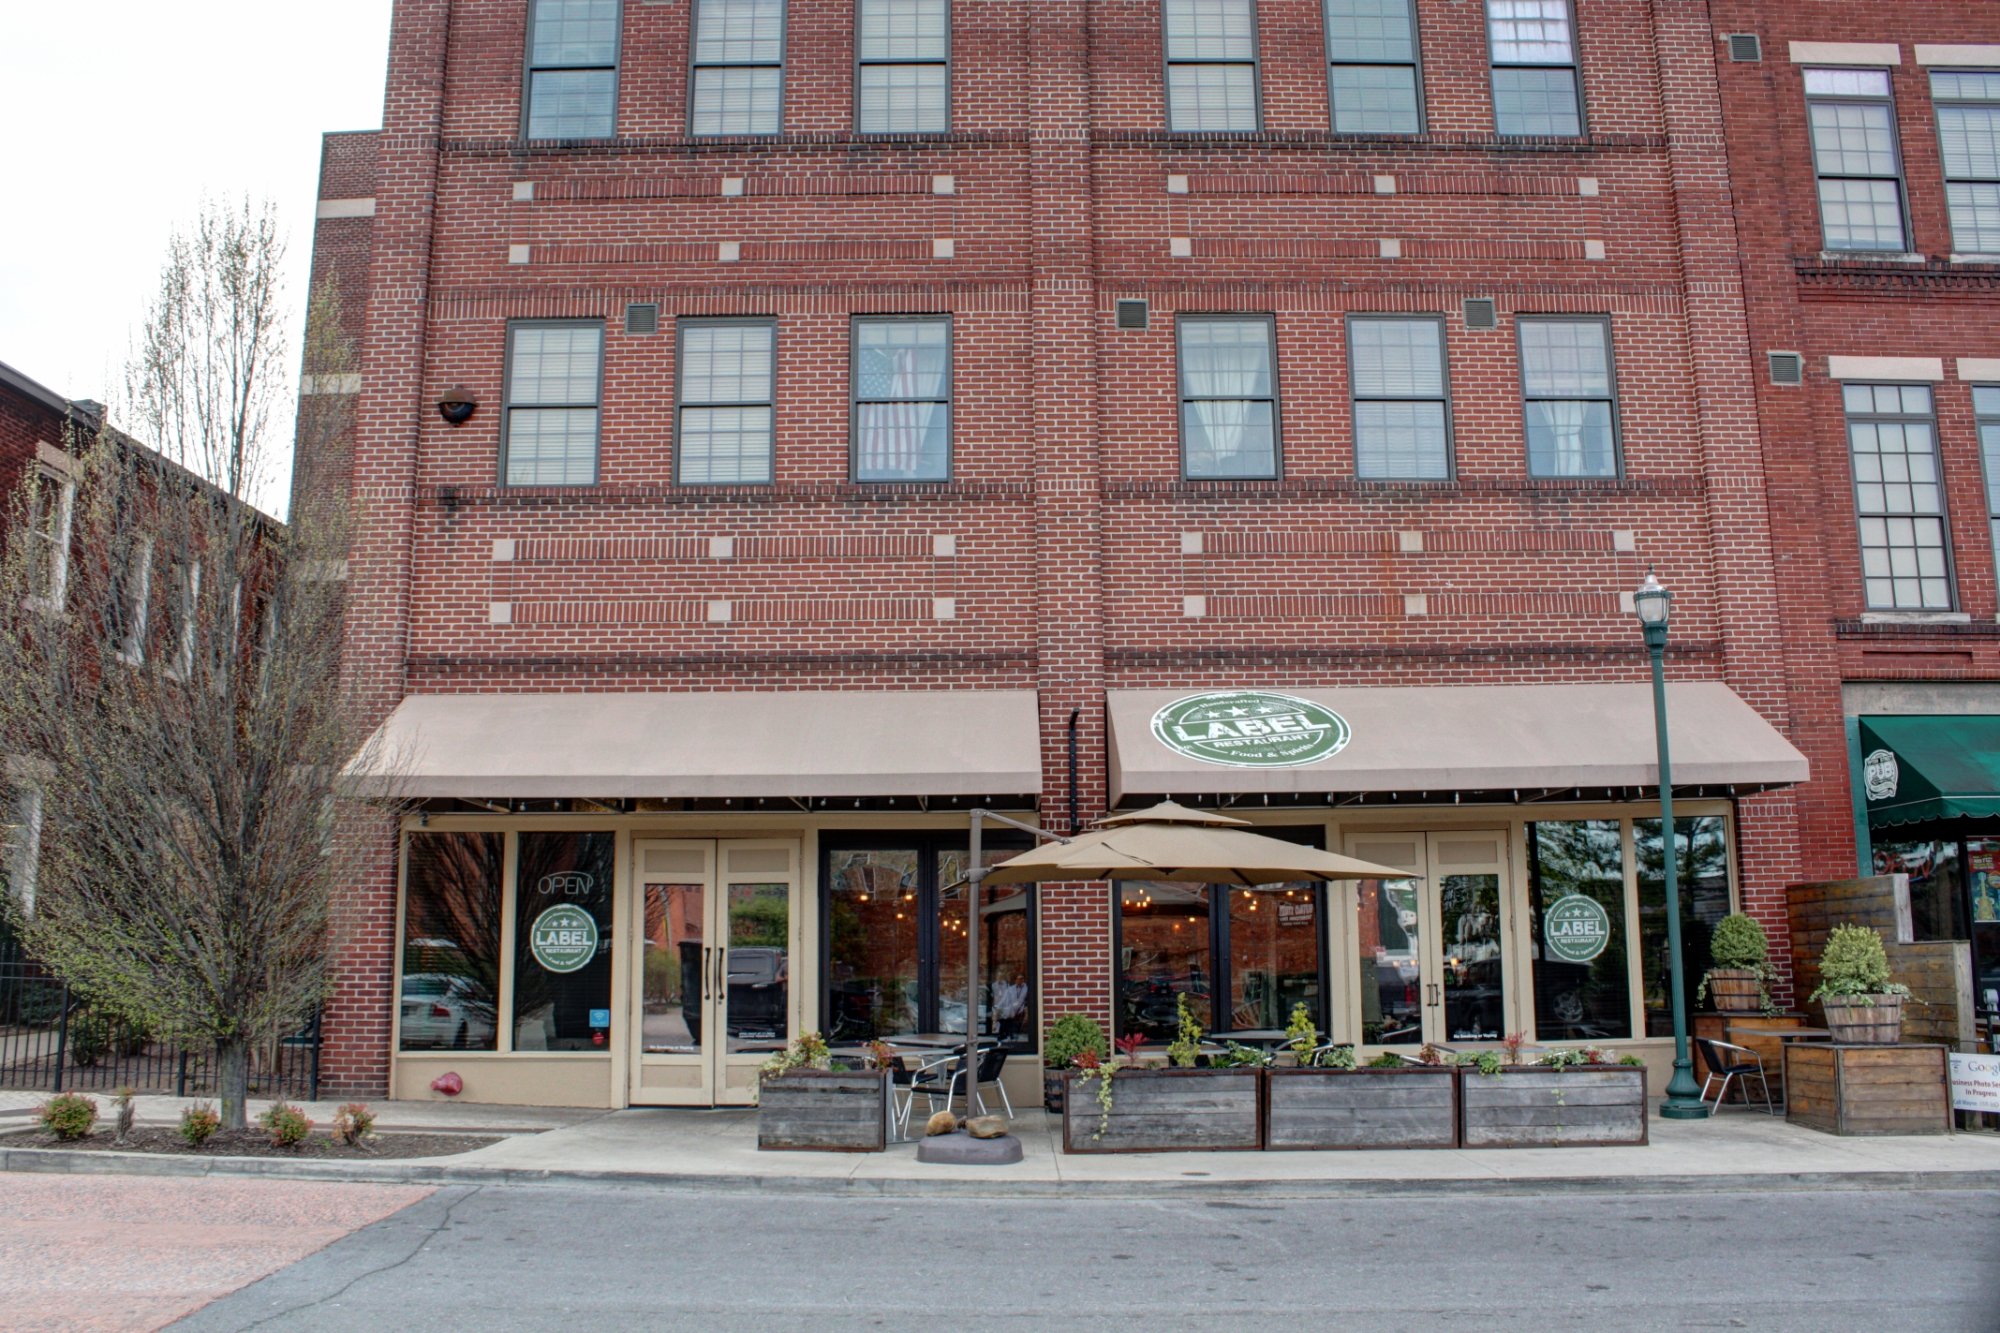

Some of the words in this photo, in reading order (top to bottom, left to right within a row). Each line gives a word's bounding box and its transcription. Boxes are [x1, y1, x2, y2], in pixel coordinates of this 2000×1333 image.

[1171, 714, 1332, 742] LABEL
[1213, 733, 1311, 748] RESTAURANT
[1230, 750, 1263, 759] Food
[1266, 750, 1279, 758] &
[538, 874, 591, 894] OPEN
[1550, 921, 1606, 936] LABEL
[536, 931, 593, 945] LABEL
[1951, 1079, 1973, 1087] usiness
[1973, 1080, 1991, 1088] Photo
[1972, 1088, 1998, 1098] Progress
